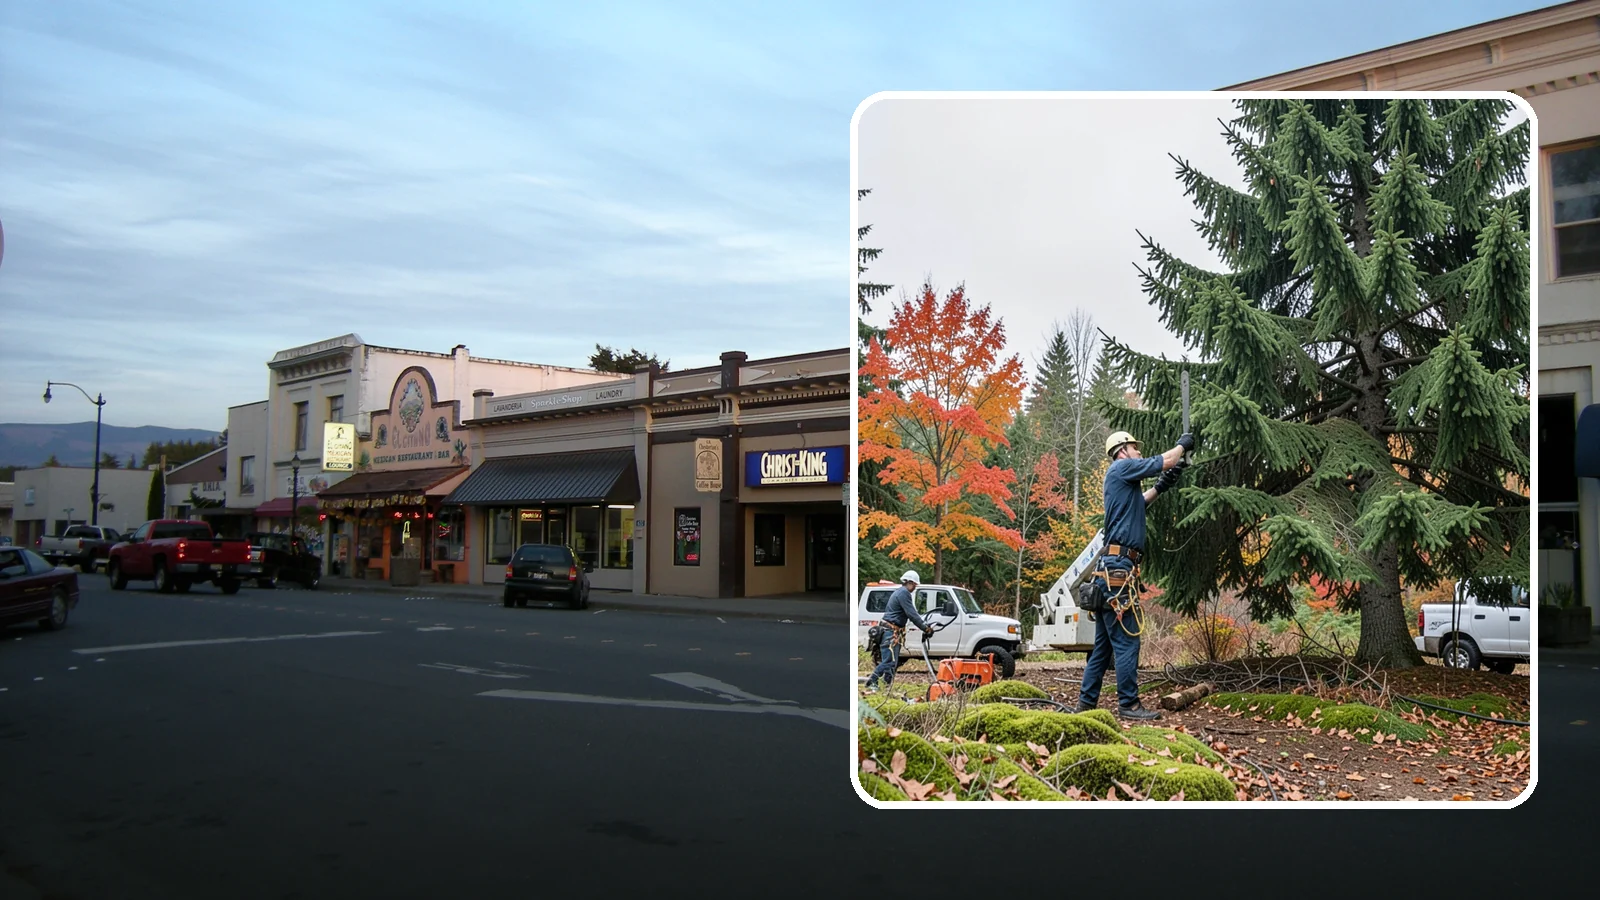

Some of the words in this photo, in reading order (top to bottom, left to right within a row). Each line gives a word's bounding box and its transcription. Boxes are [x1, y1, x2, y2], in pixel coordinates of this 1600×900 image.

[596, 389, 624, 400] LAUNDRY
[493, 402, 523, 413] LAVANDERIA
[530, 397, 561, 409] Sparkle
[562, 395, 583, 404] Shop
[397, 452, 433, 462] RESTAURANT
[437, 450, 450, 459] BAR
[761, 452, 797, 477] CHRIST
[799, 450, 827, 476] KING
